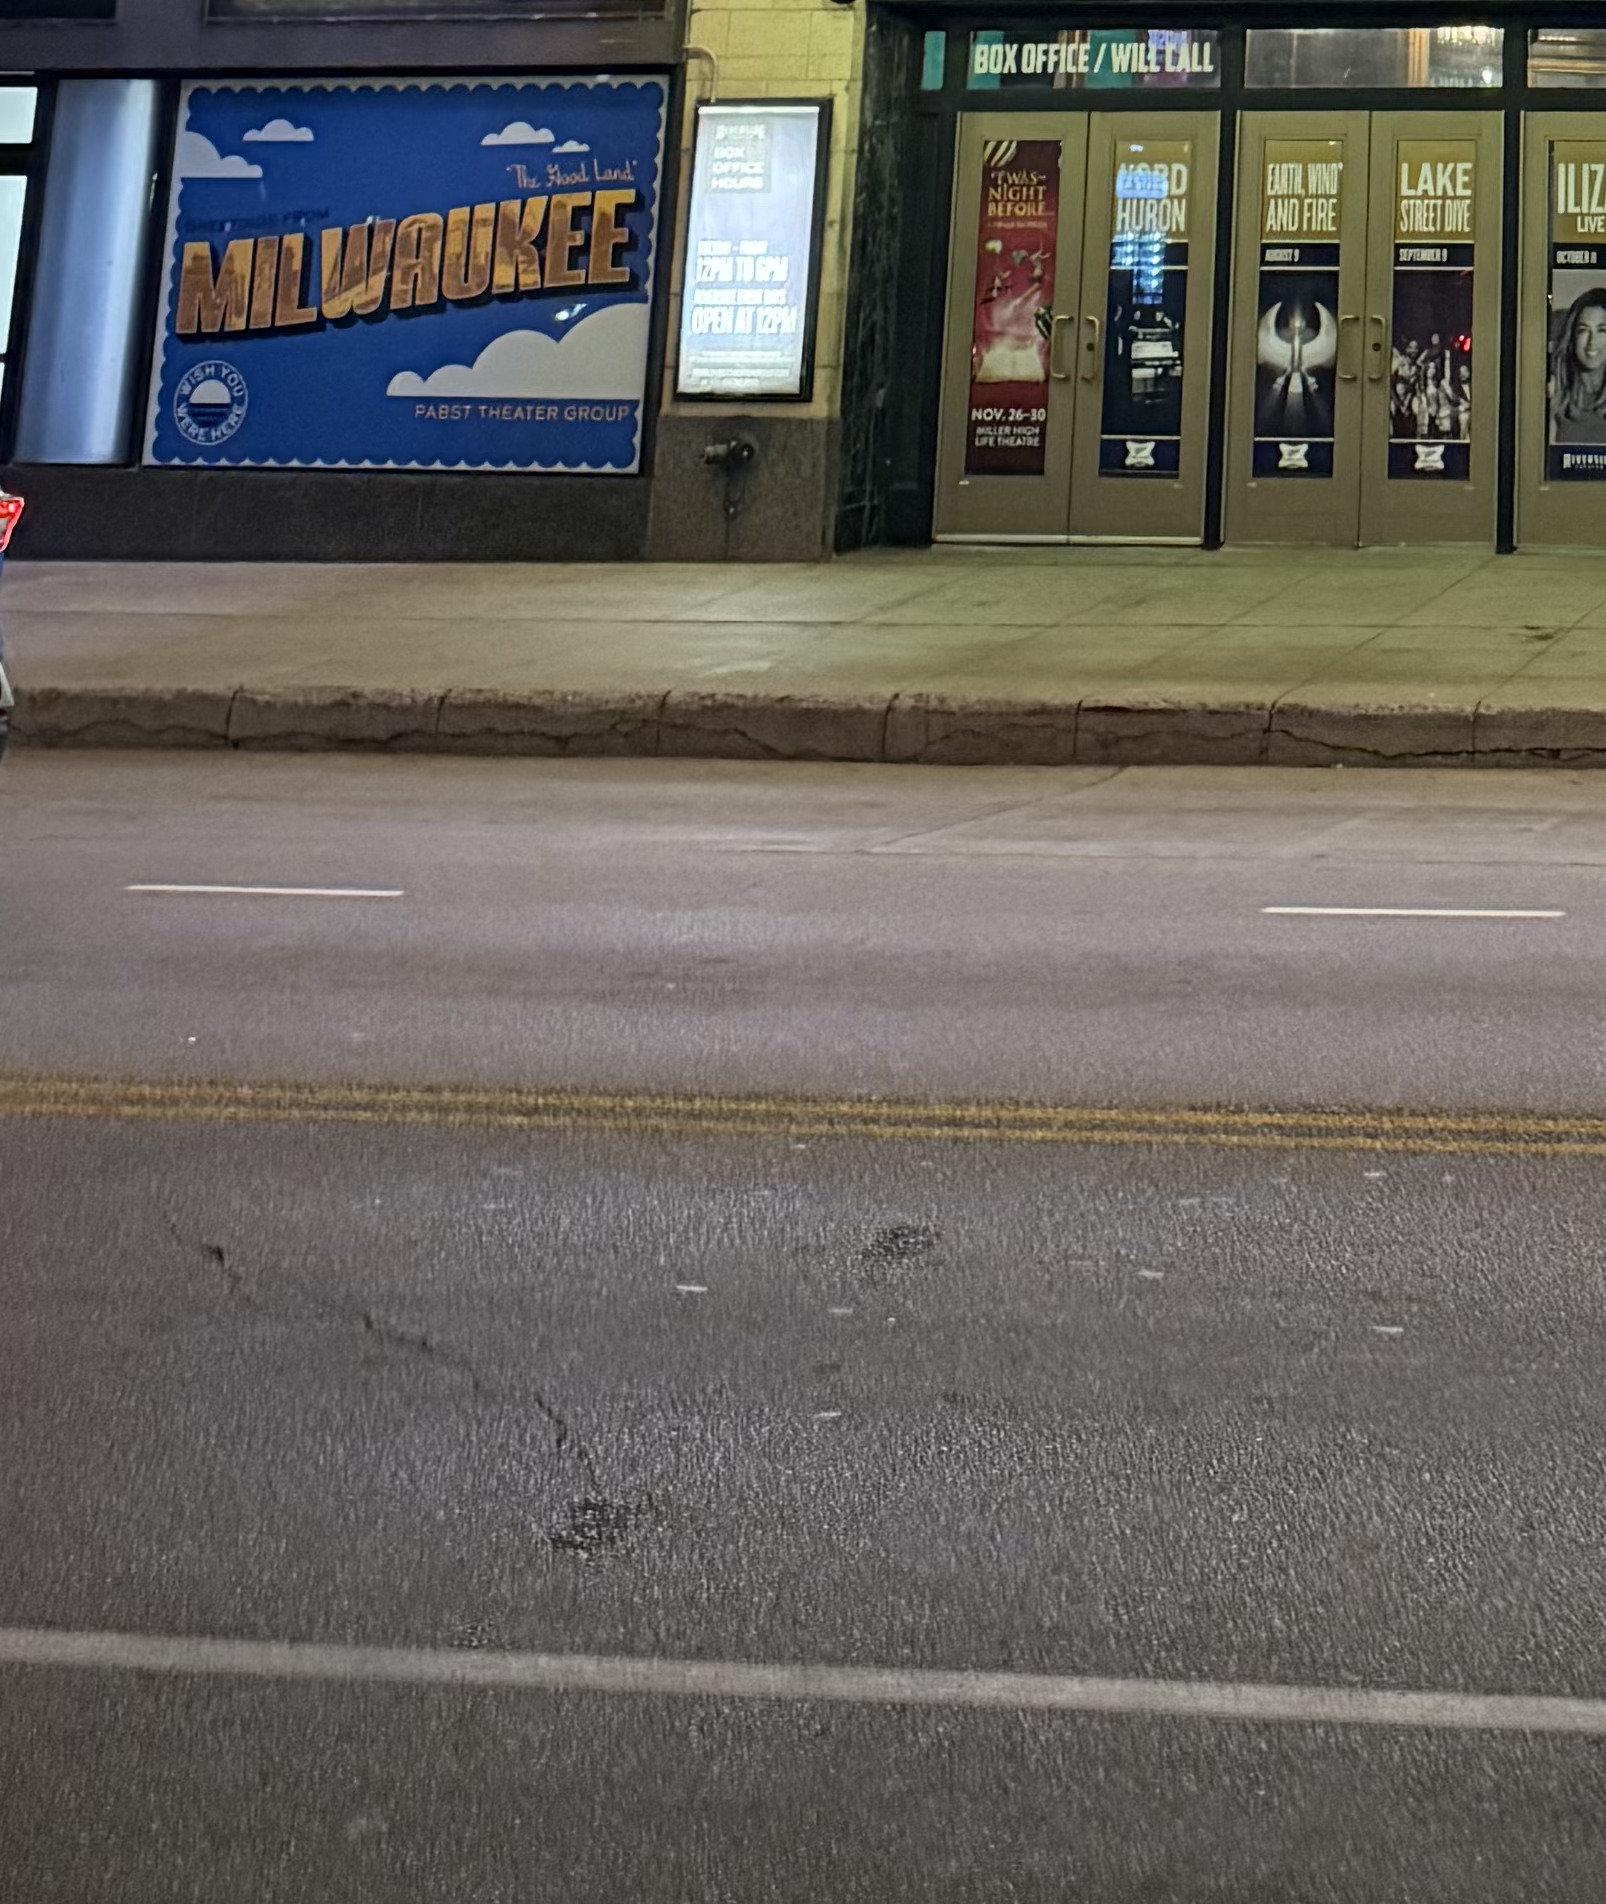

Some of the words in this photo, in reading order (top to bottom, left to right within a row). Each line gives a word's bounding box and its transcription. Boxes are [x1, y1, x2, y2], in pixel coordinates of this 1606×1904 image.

[974, 43, 1017, 74] BOX
[1021, 43, 1089, 74] OFFICE
[1093, 43, 1106, 74] /
[1111, 42, 1160, 73] WILL
[1164, 42, 1214, 73] CALL
[988, 185, 1047, 201] NIGHT
[1266, 162, 1305, 198] EARTH,
[1400, 162, 1473, 197] LAKE
[1116, 198, 1186, 232] HURON
[1266, 198, 1299, 232] AND
[1303, 198, 1337, 232] FIRE
[1400, 198, 1443, 232] STREET
[1444, 198, 1472, 232] DIVE
[1576, 215, 1606, 233] LIVE
[175, 189, 637, 335] MILWAUKEE
[1399, 248, 1441, 262] SEPTEMBER
[692, 306, 733, 334] OPEN
[180, 365, 215, 395] WISH
[221, 366, 244, 397] YOU
[177, 402, 209, 441] WERE
[211, 403, 245, 441] HERE
[415, 405, 472, 421] PABST
[478, 405, 557, 421] THEATER
[564, 405, 630, 421] GROUP
[975, 425, 1011, 436] MILLER
[1013, 425, 1040, 436] HIGH
[975, 436, 995, 447] LIFE
